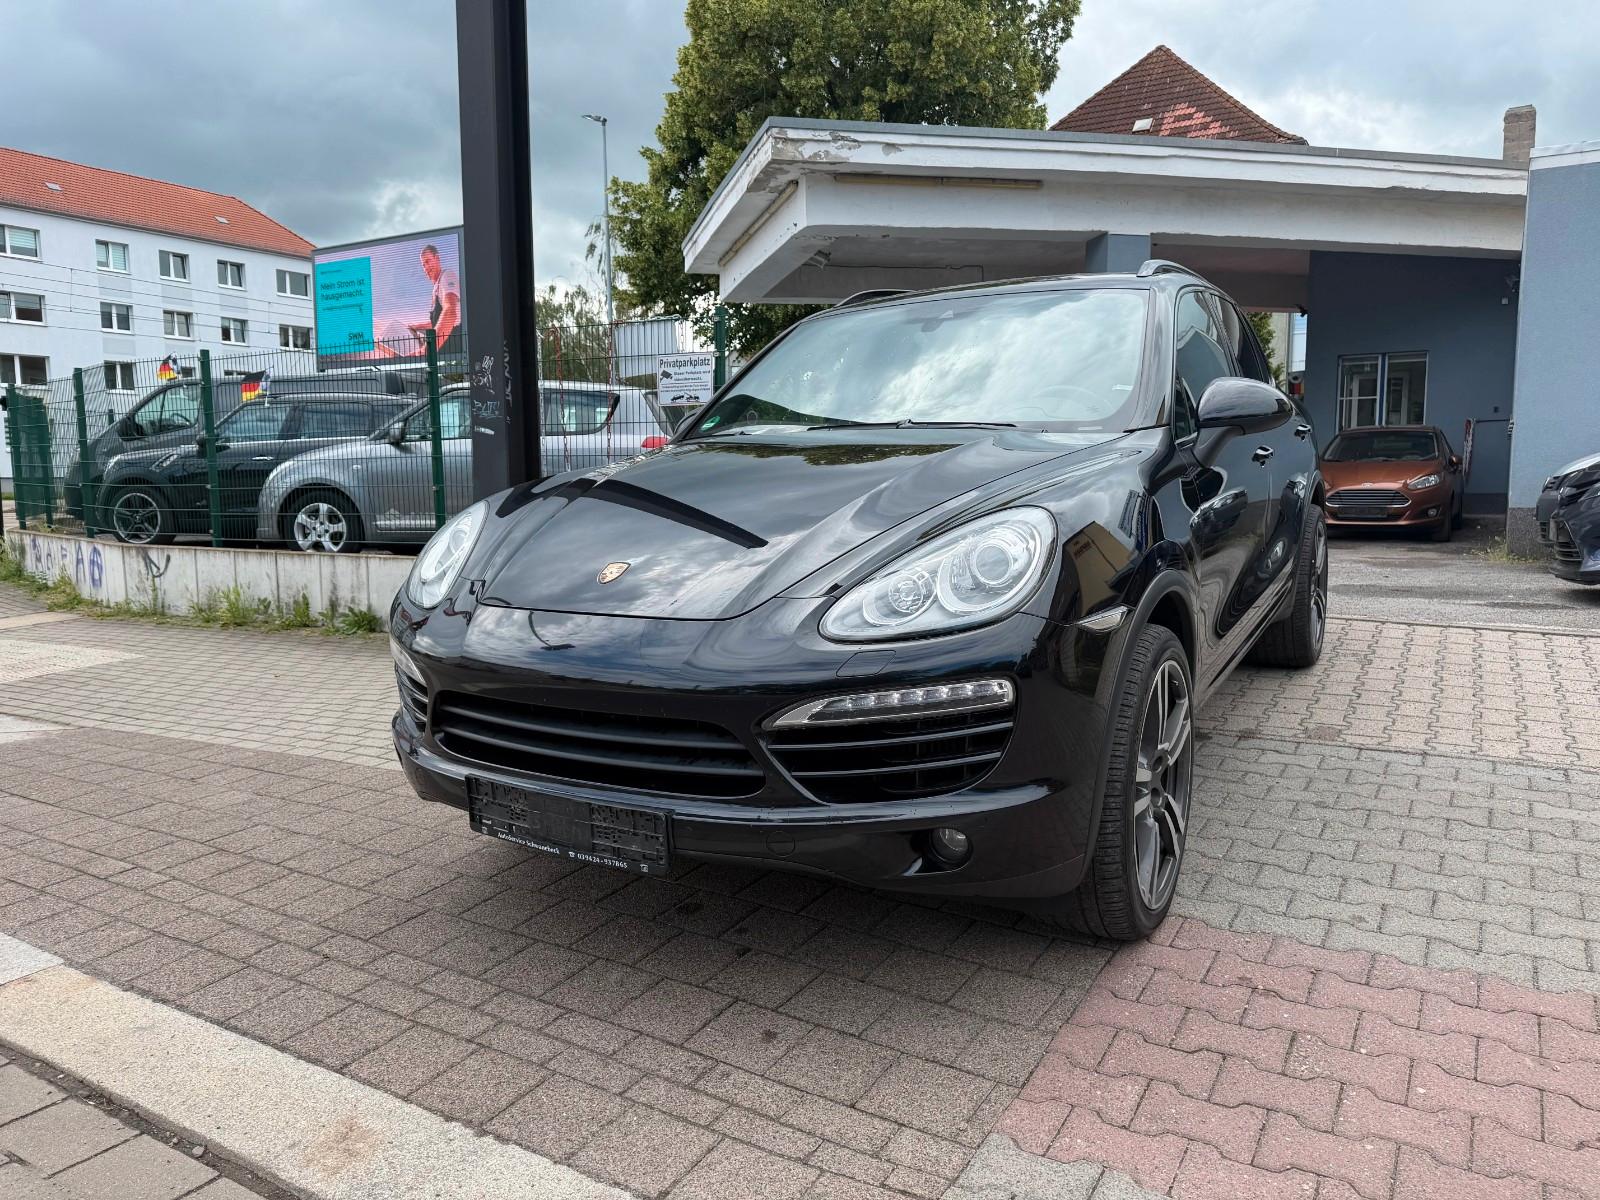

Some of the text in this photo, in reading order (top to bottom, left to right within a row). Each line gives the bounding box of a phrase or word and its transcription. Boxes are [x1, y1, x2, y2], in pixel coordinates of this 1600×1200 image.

[320, 282, 335, 290] Mein
[336, 280, 355, 289] Strom
[348, 332, 364, 340] SWM
[660, 357, 711, 369] Privatparkplatz
